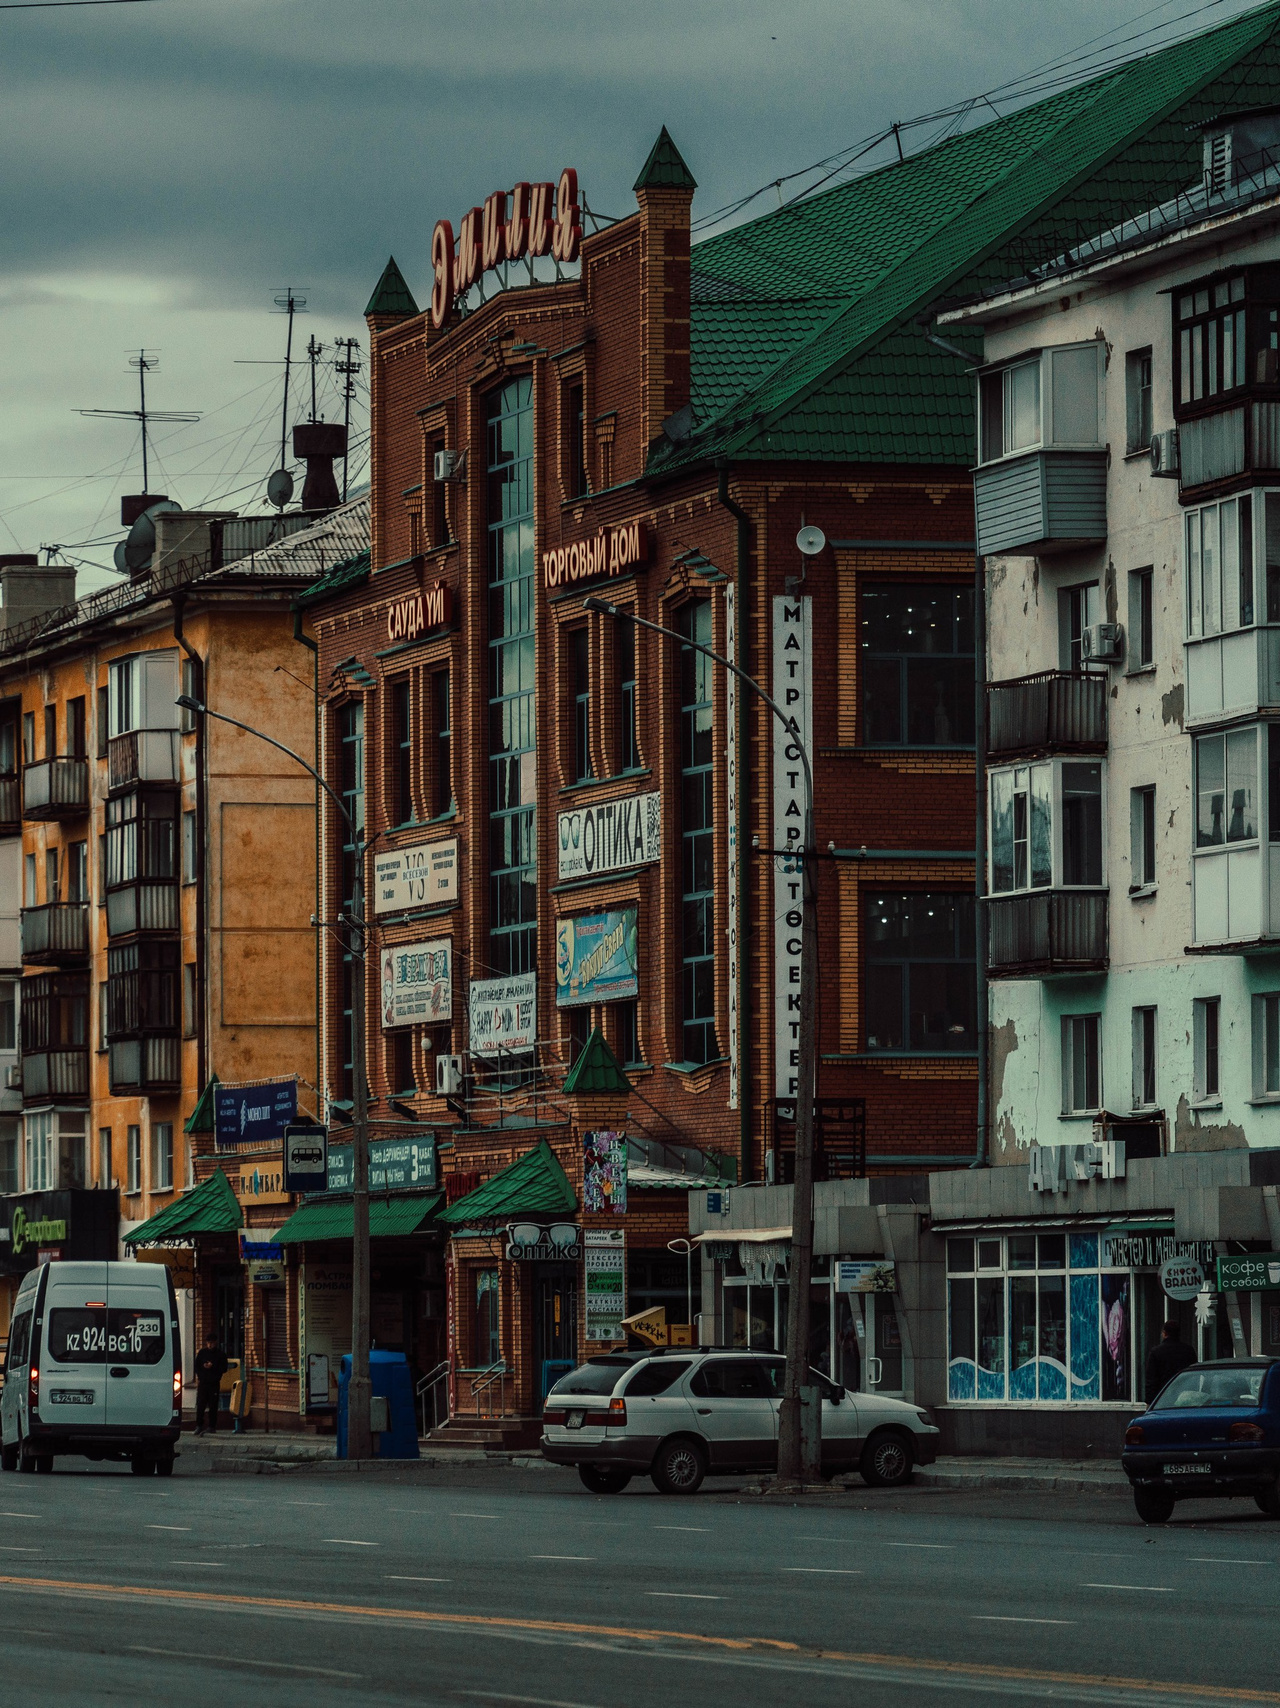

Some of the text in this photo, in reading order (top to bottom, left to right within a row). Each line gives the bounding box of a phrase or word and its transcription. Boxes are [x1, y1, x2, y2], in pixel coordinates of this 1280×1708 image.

[543, 523, 641, 589] ТОРГОВЫЙ ДОМ
[388, 581, 446, 641] САУДА ҮЙІ
[784, 604, 802, 843] МАТРАСТАР
[583, 799, 645, 873] ОПТИКА
[402, 867, 429, 880] ВСЕСЕЗОН
[411, 1144, 418, 1180] 3
[609, 1140, 621, 1205] ЦВЕТЫ
[587, 1272, 597, 1283] 20
[1164, 1275, 1202, 1288] BRAUN
[1222, 1276, 1267, 1288] с собой
[307, 1281, 353, 1291] ЛОМБАР
[612, 1282, 623, 1293] 20
[139, 1323, 159, 1332] 230
[66, 1326, 142, 1353] KZ 924 BG 16
[58, 1394, 72, 1402] 924
